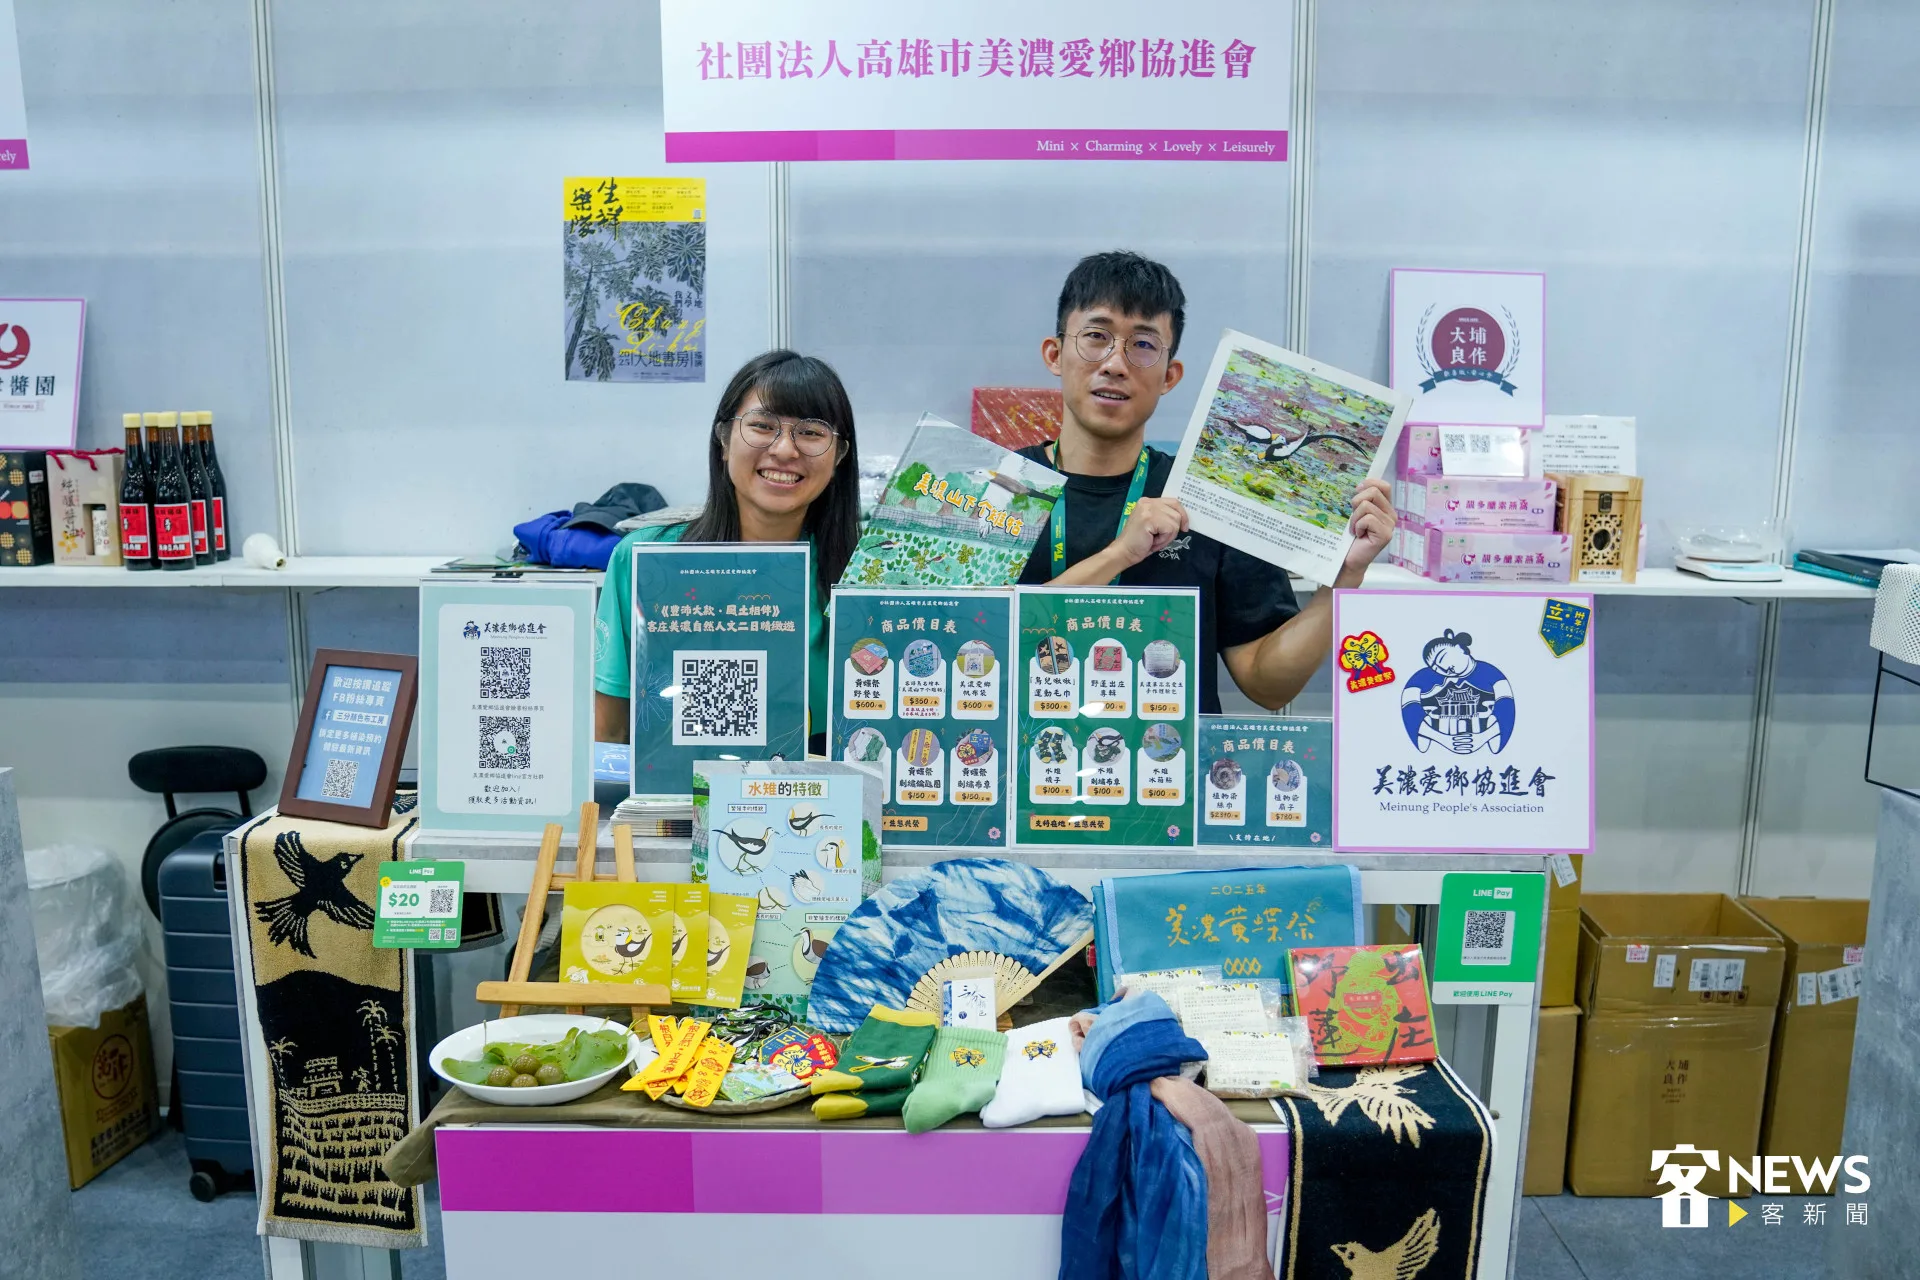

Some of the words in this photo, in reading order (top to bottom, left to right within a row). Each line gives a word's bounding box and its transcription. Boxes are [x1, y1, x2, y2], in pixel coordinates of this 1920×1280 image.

[695, 38, 1257, 82] 社團法人高雄市美濃愛鄉協進會
[1036, 140, 1065, 152] Mini
[1085, 140, 1143, 154] Charming
[1164, 141, 1202, 155] Lovely
[1223, 142, 1276, 155] Leisurely
[1449, 327, 1487, 345] 大埔
[1449, 346, 1488, 365] 良作
[0, 375, 55, 397] 醬園
[881, 617, 958, 634] 商品價目表
[1066, 616, 1144, 633] 商品價目表
[855, 678, 881, 688] 黃蝶祭
[853, 689, 881, 699] 野餐墊
[1034, 689, 1071, 697] 運動毛巾
[1222, 738, 1295, 754] 商品價目表
[908, 767, 933, 777] 黃蝶祭
[961, 768, 988, 777] 黃蝶祭
[748, 781, 823, 797] 水雉的特徵
[1372, 765, 1556, 798] 美濃愛鄉協進會
[1379, 802, 1430, 814] Meinung
[1432, 802, 1478, 815] People's
[1480, 803, 1545, 814] Association
[388, 892, 420, 908] $20
[1472, 889, 1493, 897] LINE
[1496, 890, 1511, 898] Pay
[1498, 990, 1513, 998] Pay
